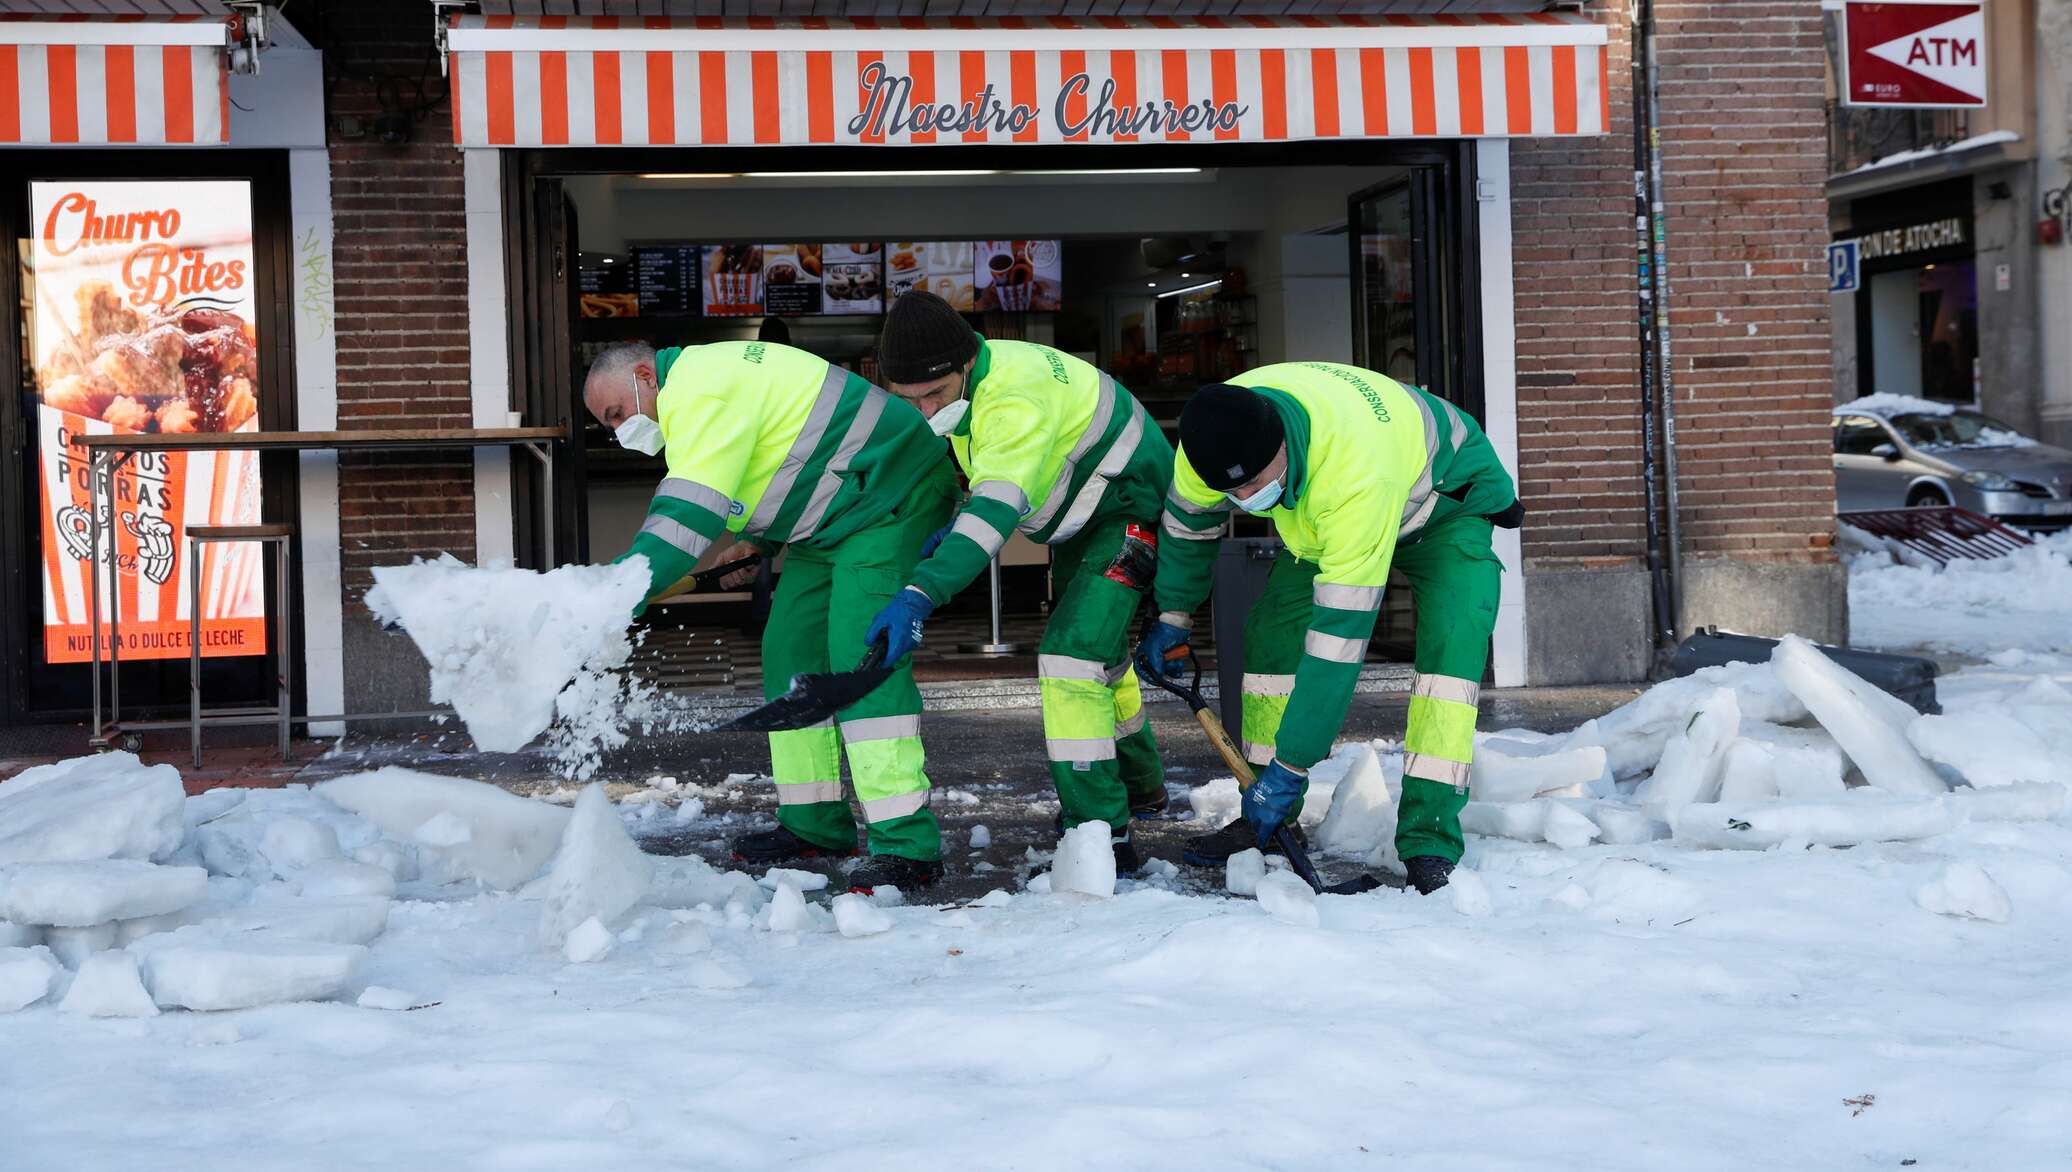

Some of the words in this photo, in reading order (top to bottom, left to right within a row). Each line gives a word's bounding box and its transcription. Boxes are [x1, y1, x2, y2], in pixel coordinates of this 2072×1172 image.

[1906, 37, 1977, 66] ATM
[847, 60, 1041, 137] Maestro
[1054, 73, 1249, 137] Churrero
[1875, 83, 1902, 93] EURO
[43, 192, 181, 257] Churro
[1883, 228, 1903, 256] DE
[1904, 217, 1962, 253] ATOCHA
[122, 243, 246, 307] Bites
[1833, 247, 1848, 287] P
[129, 633, 138, 649] O
[142, 632, 183, 649] DULCE
[206, 629, 245, 646] LECHE
